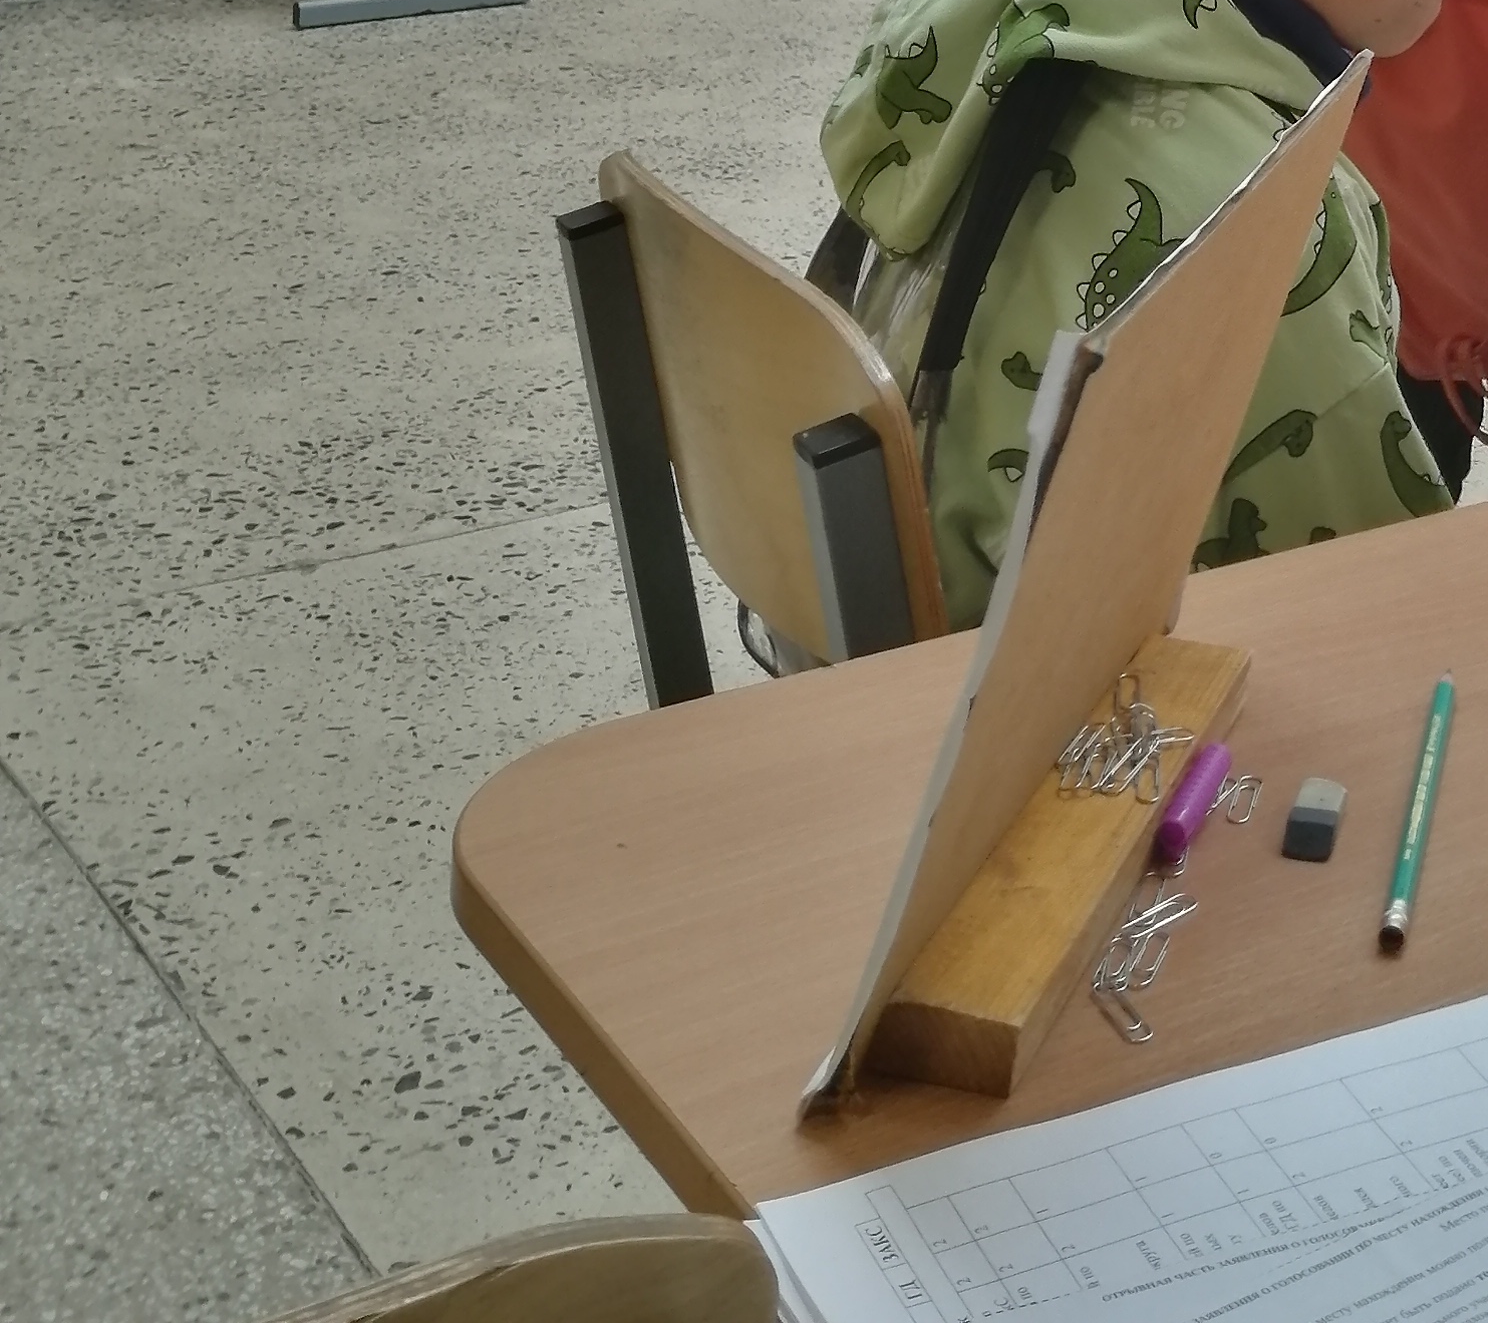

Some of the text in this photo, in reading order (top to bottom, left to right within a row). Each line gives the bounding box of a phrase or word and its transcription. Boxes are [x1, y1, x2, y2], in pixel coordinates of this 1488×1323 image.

[1271, 1249, 1355, 1291] ГОЛОСОВАНИИ
[1355, 1235, 1373, 1253] ПО
[1373, 1223, 1410, 1247] МЕСТУ
[1411, 1189, 1485, 1228] НАХОЖДЕНИЯ
[1440, 1209, 1477, 1233] Место
[864, 1225, 900, 1264] ЗАКС
[1427, 1250, 1467, 1275] можно
[1101, 1276, 1173, 1303] ОТРЫВНАЯ
[1174, 1263, 1215, 1281] ЧАСТЬ
[1219, 1243, 1290, 1269] ЗАЯВЛЕНИЯ
